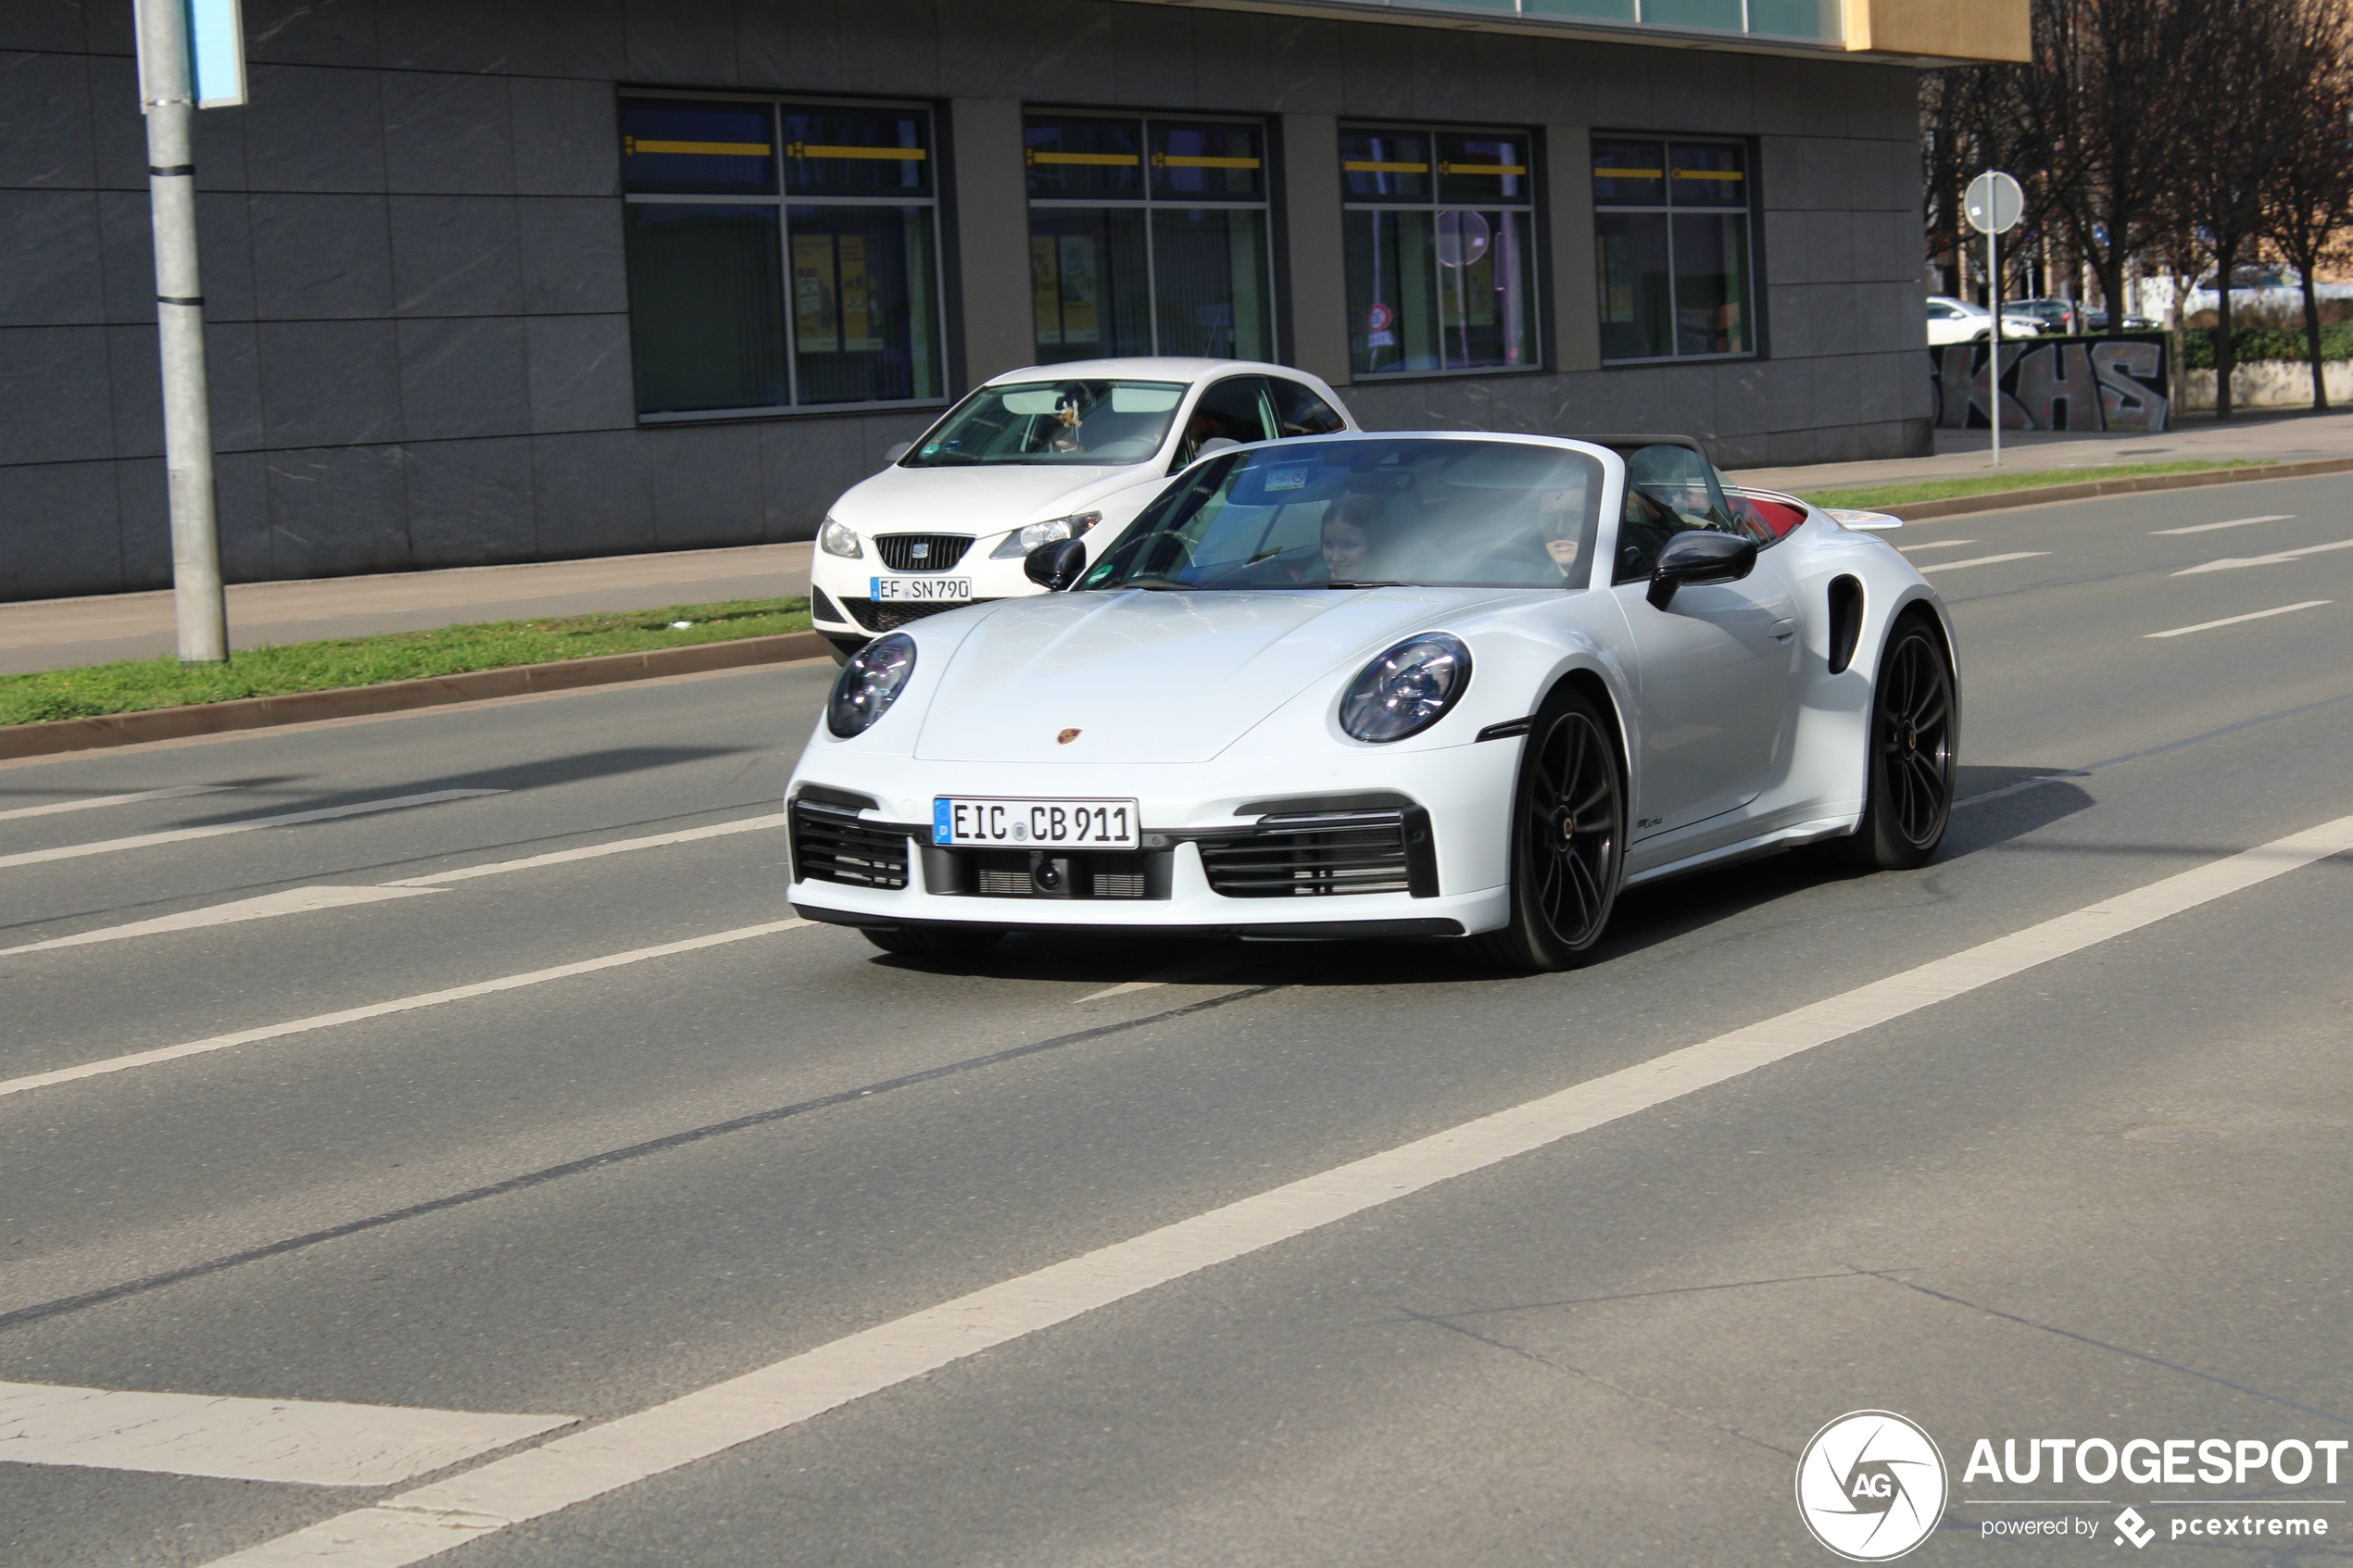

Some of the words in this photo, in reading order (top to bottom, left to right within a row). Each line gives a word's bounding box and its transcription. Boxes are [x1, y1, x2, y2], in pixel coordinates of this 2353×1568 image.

[1931, 341, 2168, 432] KHS
[880, 581, 900, 598] EF
[954, 804, 1007, 840] EIC
[1031, 806, 1066, 841] CB
[1075, 807, 1130, 842] 911
